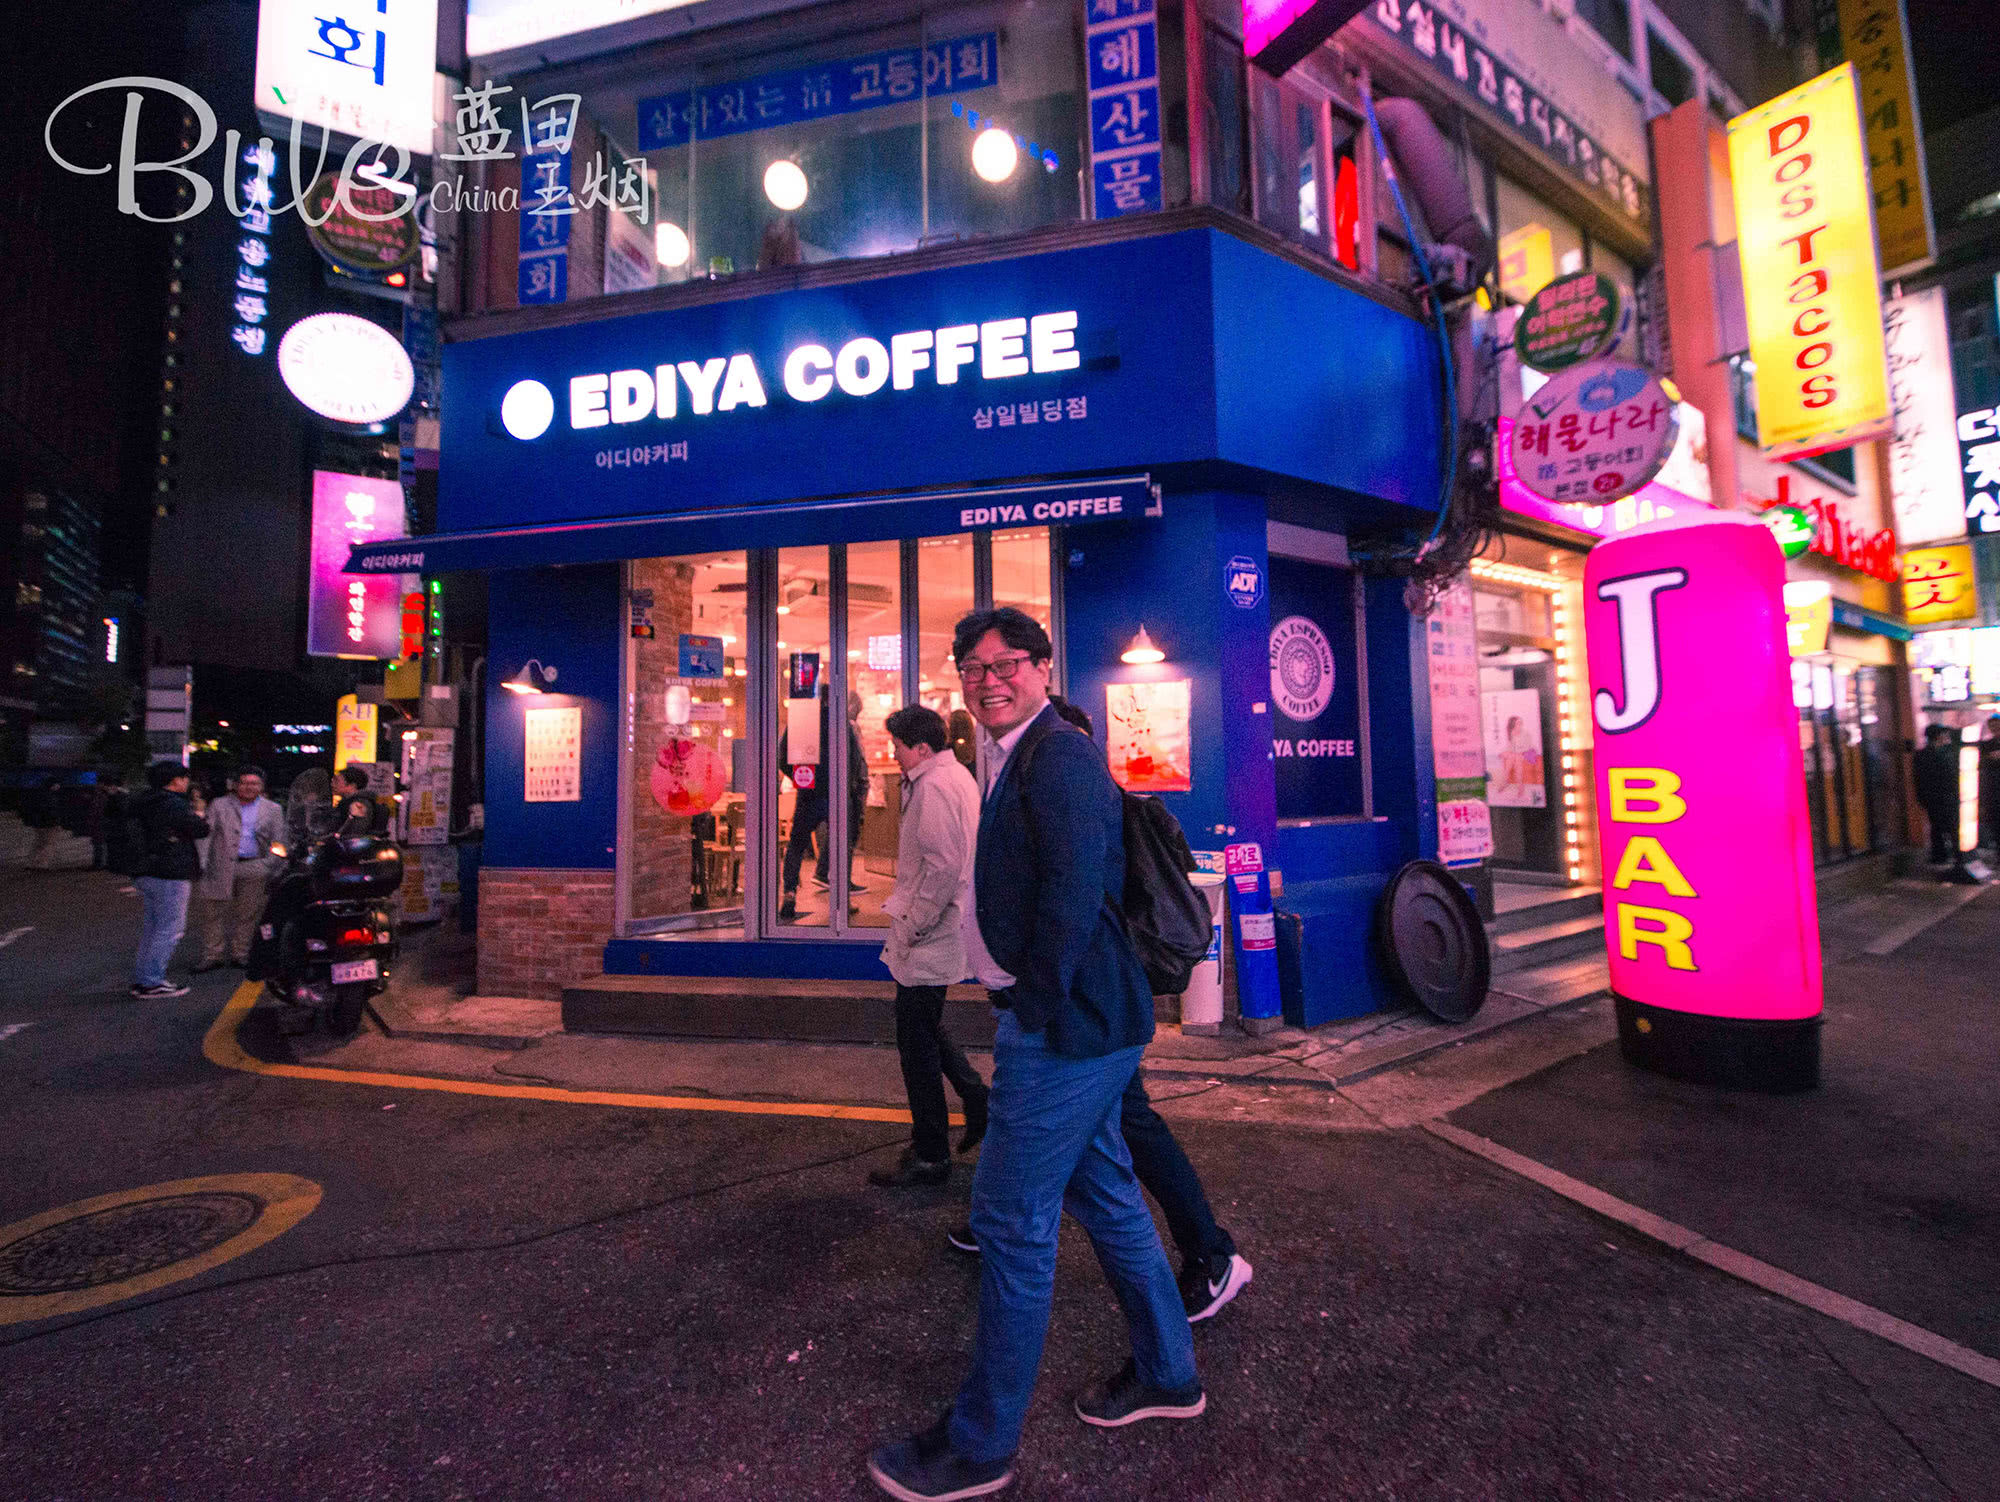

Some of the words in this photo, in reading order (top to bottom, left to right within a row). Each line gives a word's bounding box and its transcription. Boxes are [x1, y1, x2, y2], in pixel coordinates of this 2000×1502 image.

[308, 0, 386, 86] 회
[851, 40, 989, 101] 고등어회
[570, 354, 767, 429] EDIYA
[784, 310, 1080, 402] COFFEE
[973, 396, 1088, 429] 삼일빌딩점
[1520, 403, 1664, 456] 해물나라
[596, 441, 689, 470] 이디야커피
[960, 504, 1027, 527] EDIYA
[1033, 496, 1123, 520] COFFEE
[361, 552, 425, 570] 이디야커피
[1229, 573, 1258, 593] ADT
[1290, 623, 1331, 676] ESPRESSO
[1593, 567, 1689, 735] J
[1297, 740, 1355, 757] COFFEE
[1608, 767, 1700, 973] BAR
